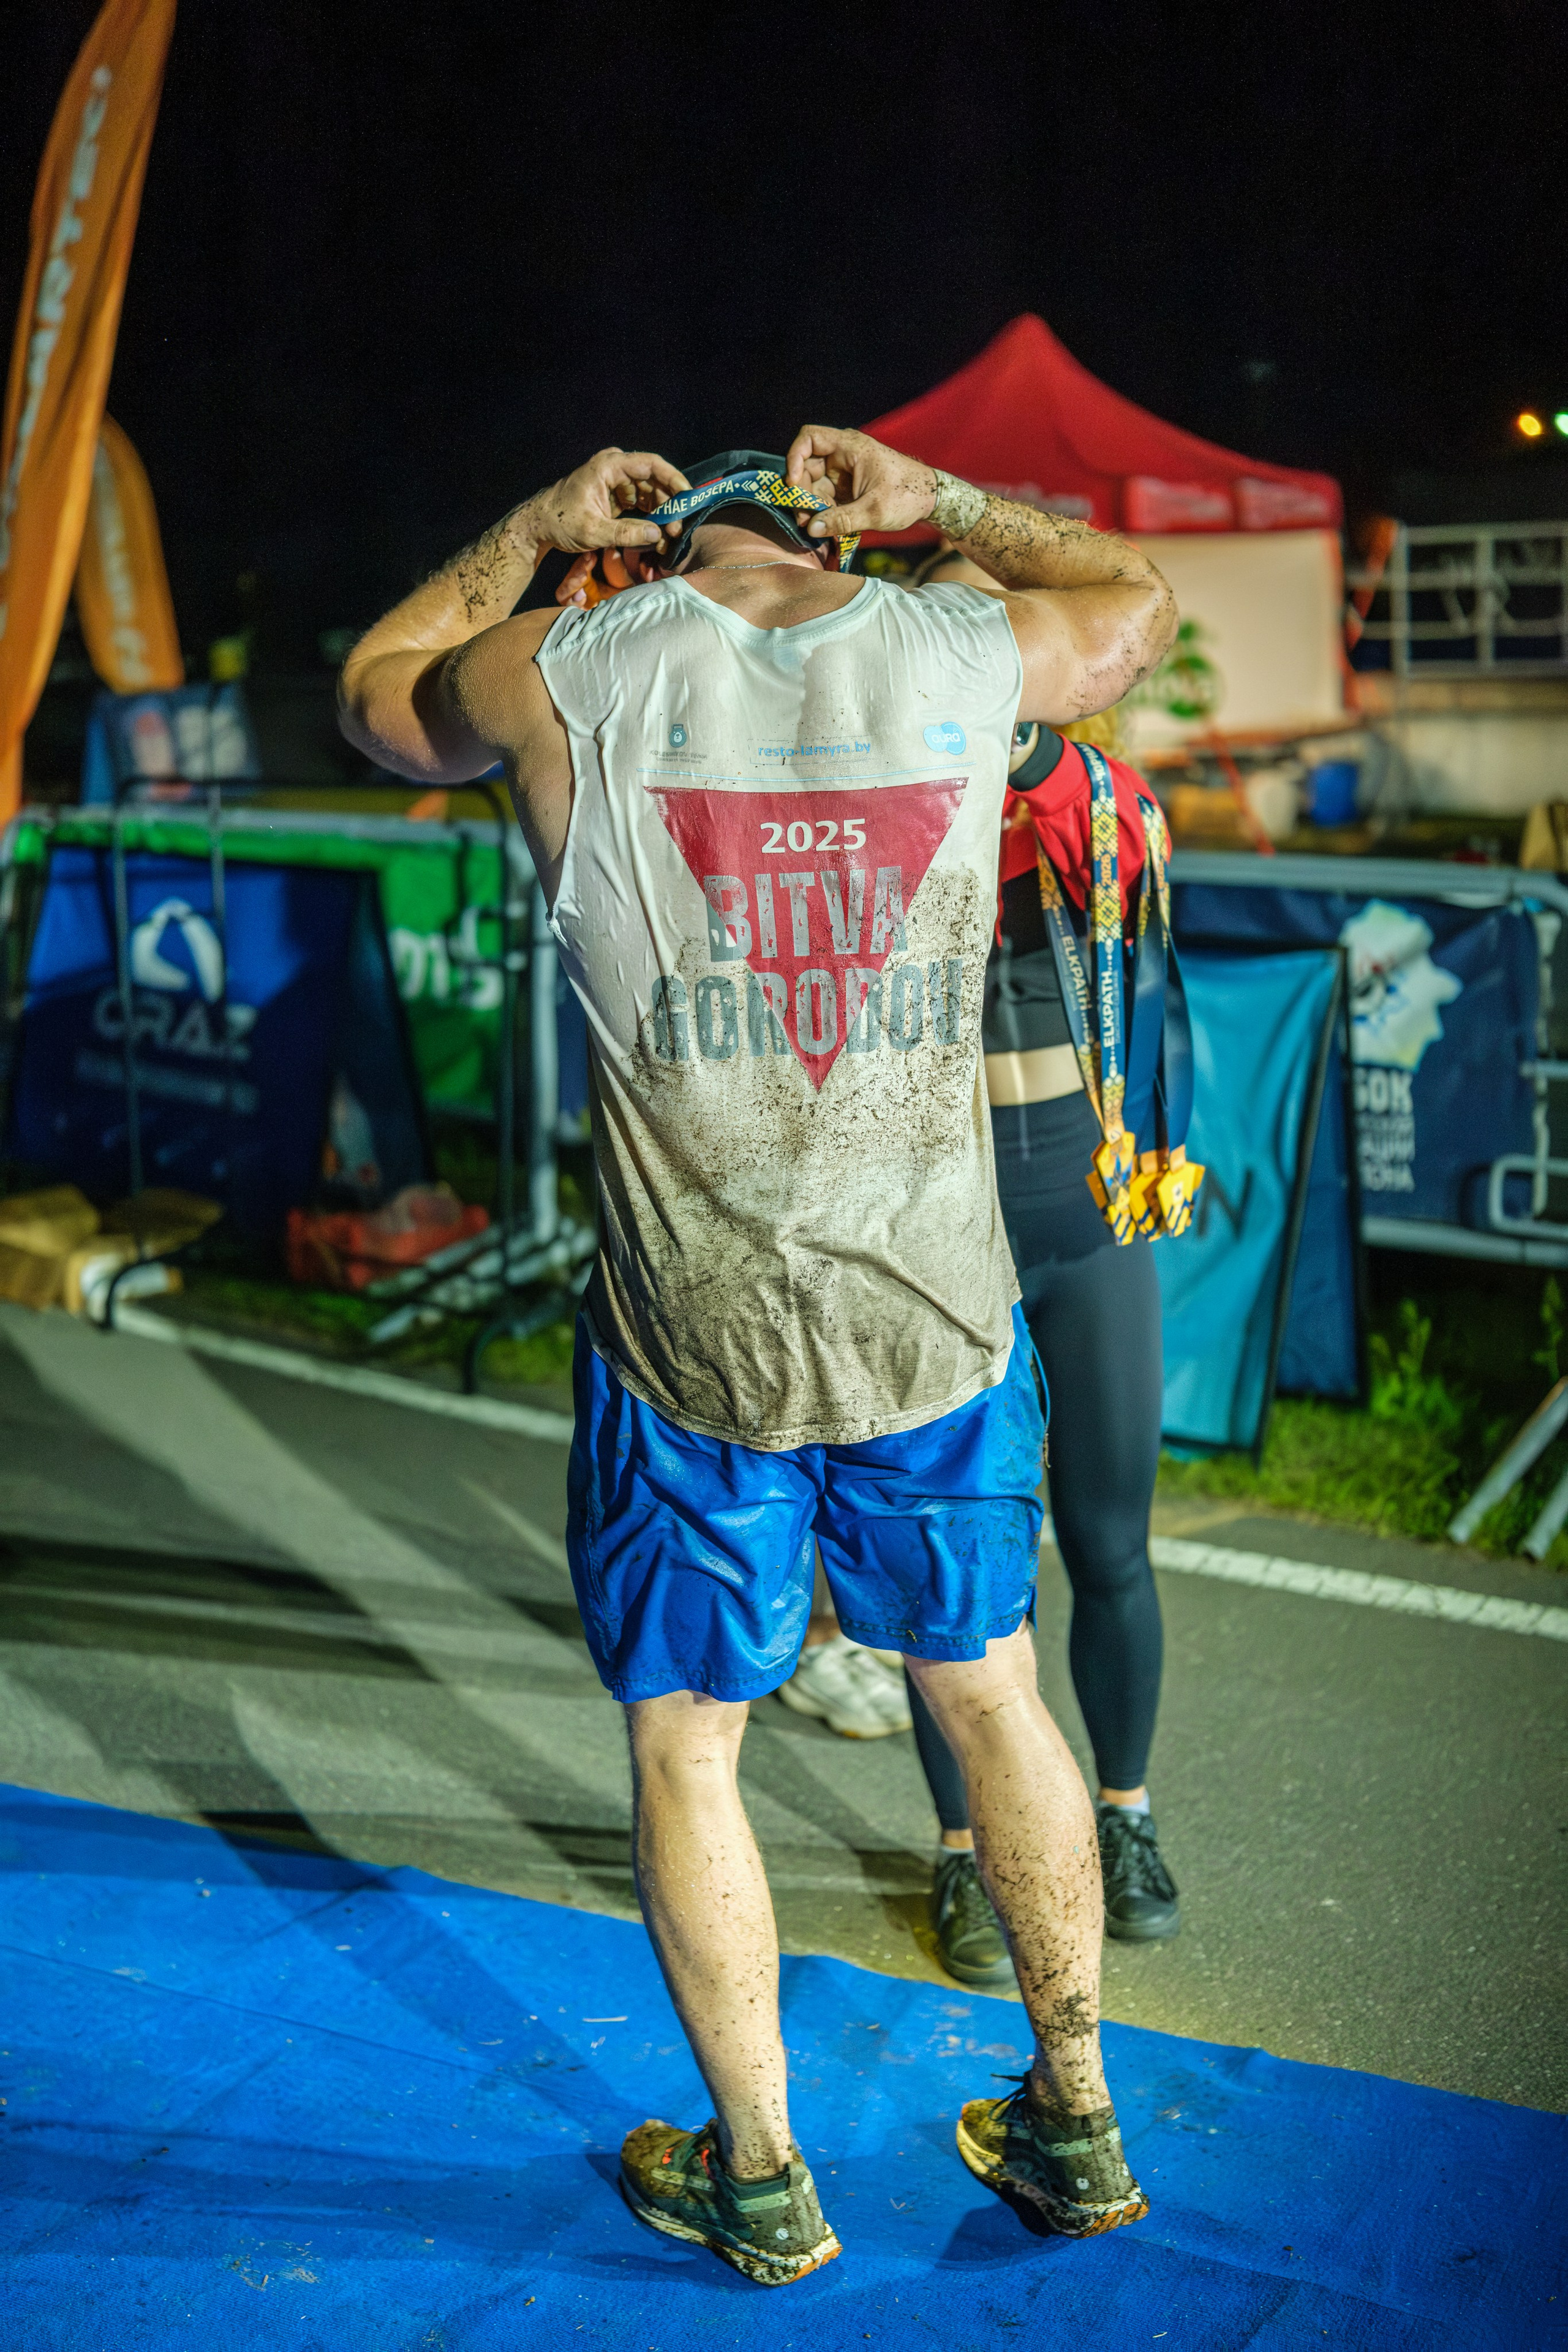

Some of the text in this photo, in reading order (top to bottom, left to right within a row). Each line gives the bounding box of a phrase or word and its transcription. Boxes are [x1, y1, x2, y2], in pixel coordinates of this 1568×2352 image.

[690, 480, 734, 507] ВОЗЕРА
[758, 741, 871, 758] resto-lamyra.by
[760, 818, 867, 853] 2025
[703, 865, 909, 963] BITVA
[650, 958, 962, 1062] GORODOV
[1101, 970, 1115, 1048] ELKPATH
